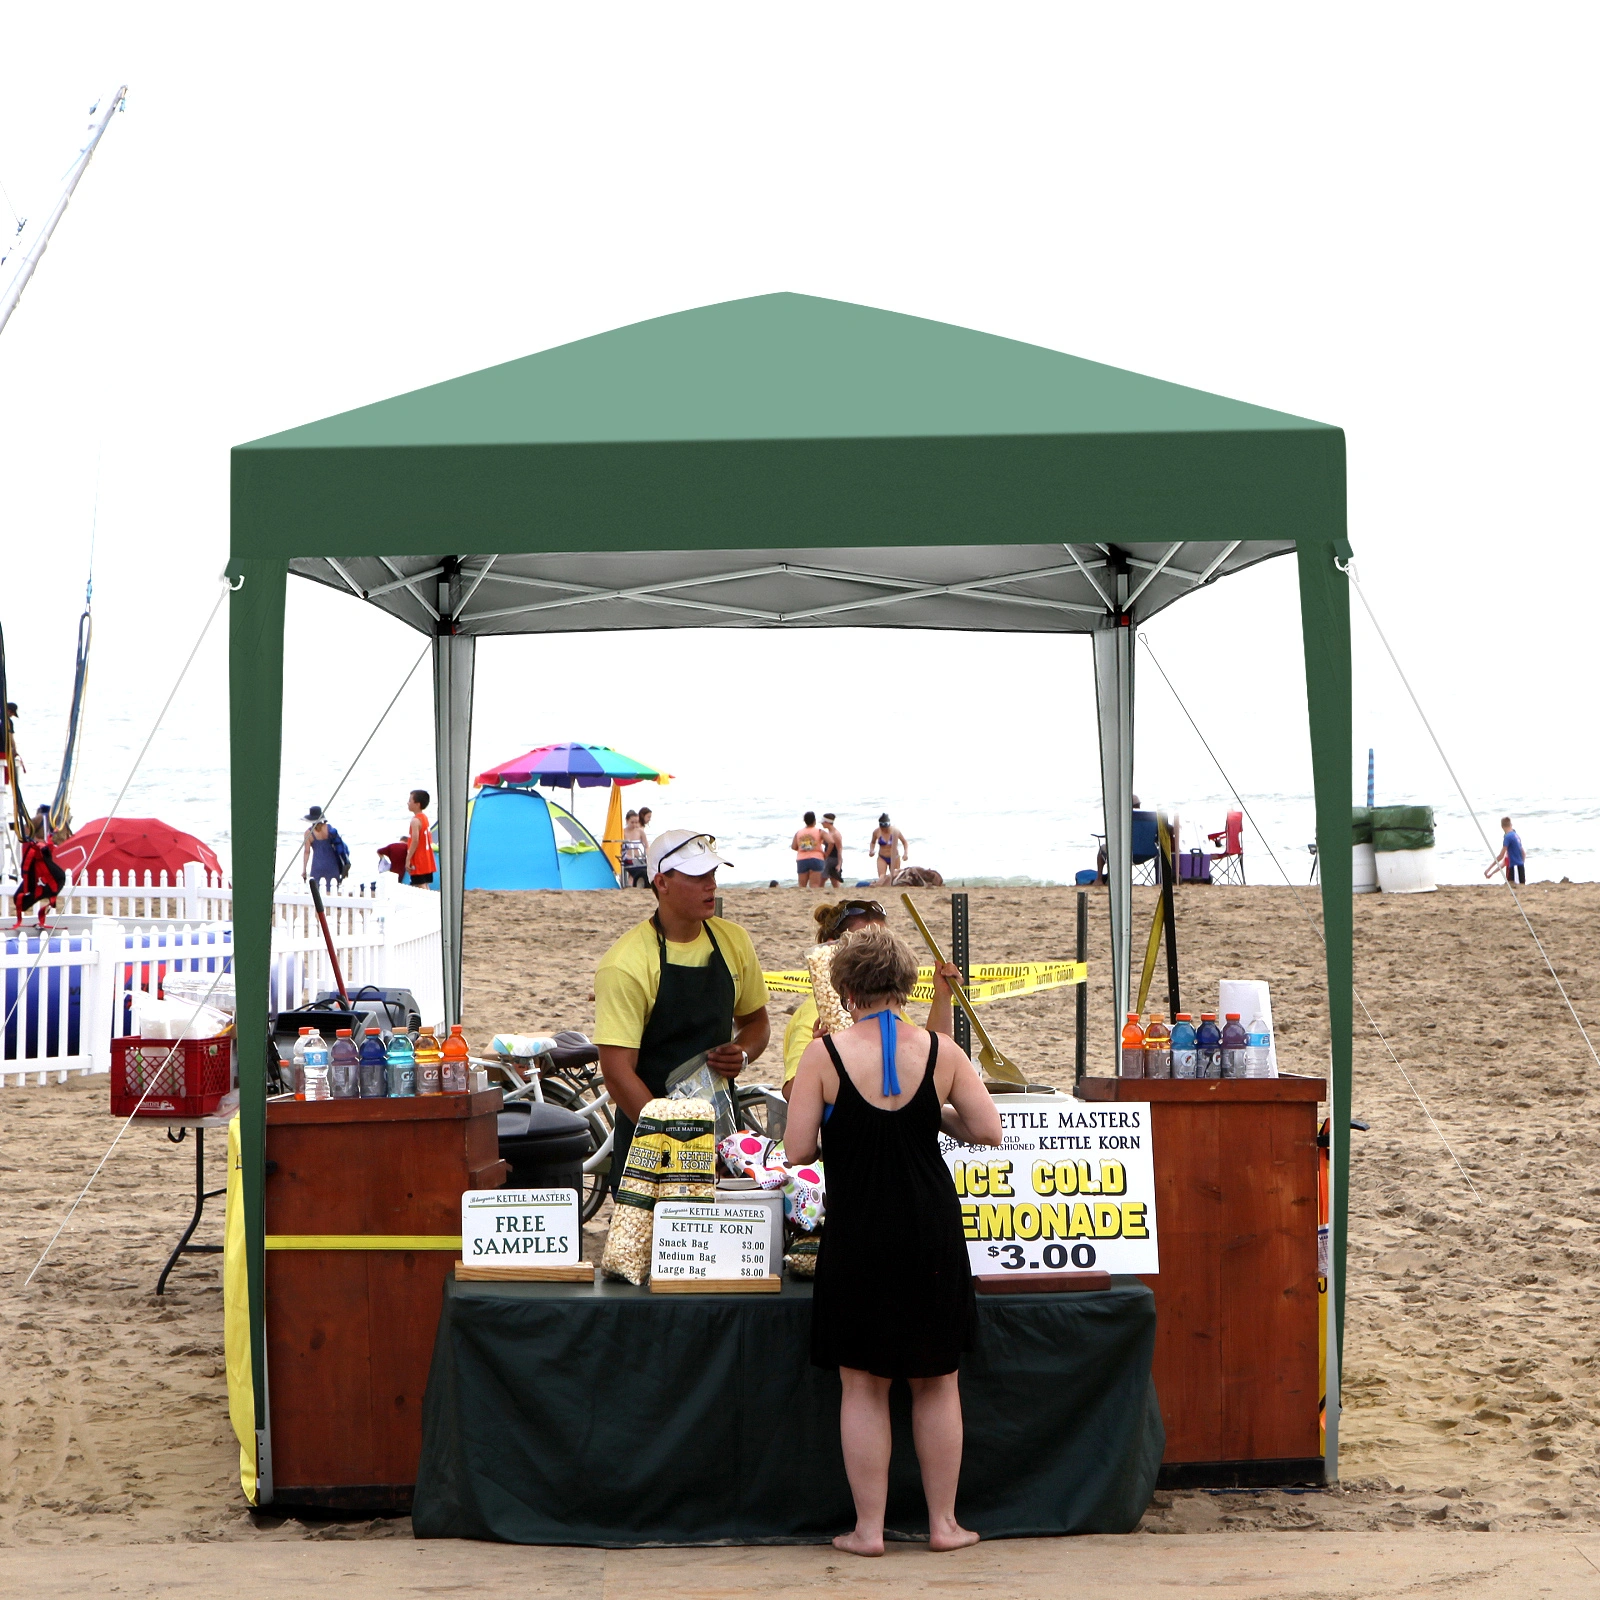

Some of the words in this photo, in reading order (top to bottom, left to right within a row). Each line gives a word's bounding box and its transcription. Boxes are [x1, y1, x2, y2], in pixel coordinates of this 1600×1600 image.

[423, 1069, 439, 1080] G2
[442, 1063, 451, 1079] G
[999, 1112, 1049, 1129] ETTLE
[1058, 1111, 1141, 1129] MASTERS
[1038, 1136, 1092, 1150] KETTLE
[1098, 1135, 1141, 1150] KORN
[682, 1160, 710, 1170] KORN
[954, 1158, 1016, 1198] ICE
[1031, 1158, 1127, 1197] COLD
[496, 1194, 527, 1203] KETTLE
[531, 1193, 571, 1202] MASTERS
[689, 1207, 720, 1217] KETTLE
[724, 1208, 765, 1219] MASTERS
[495, 1215, 546, 1233] FREE
[671, 1222, 714, 1233] KETTLE
[719, 1224, 754, 1235] KORN
[961, 1202, 1150, 1242] EMONADE
[473, 1236, 569, 1256] SAMPLES
[659, 1238, 687, 1248] Snack
[691, 1239, 709, 1250] Bag
[741, 1241, 765, 1250] $3.00
[658, 1251, 695, 1261] Medium
[699, 1253, 717, 1264] Bag
[741, 1254, 764, 1264] $5.00
[987, 1243, 1097, 1270] $3.00
[658, 1265, 685, 1276] Large
[689, 1266, 707, 1277] Bag
[740, 1268, 764, 1278] $8.00
